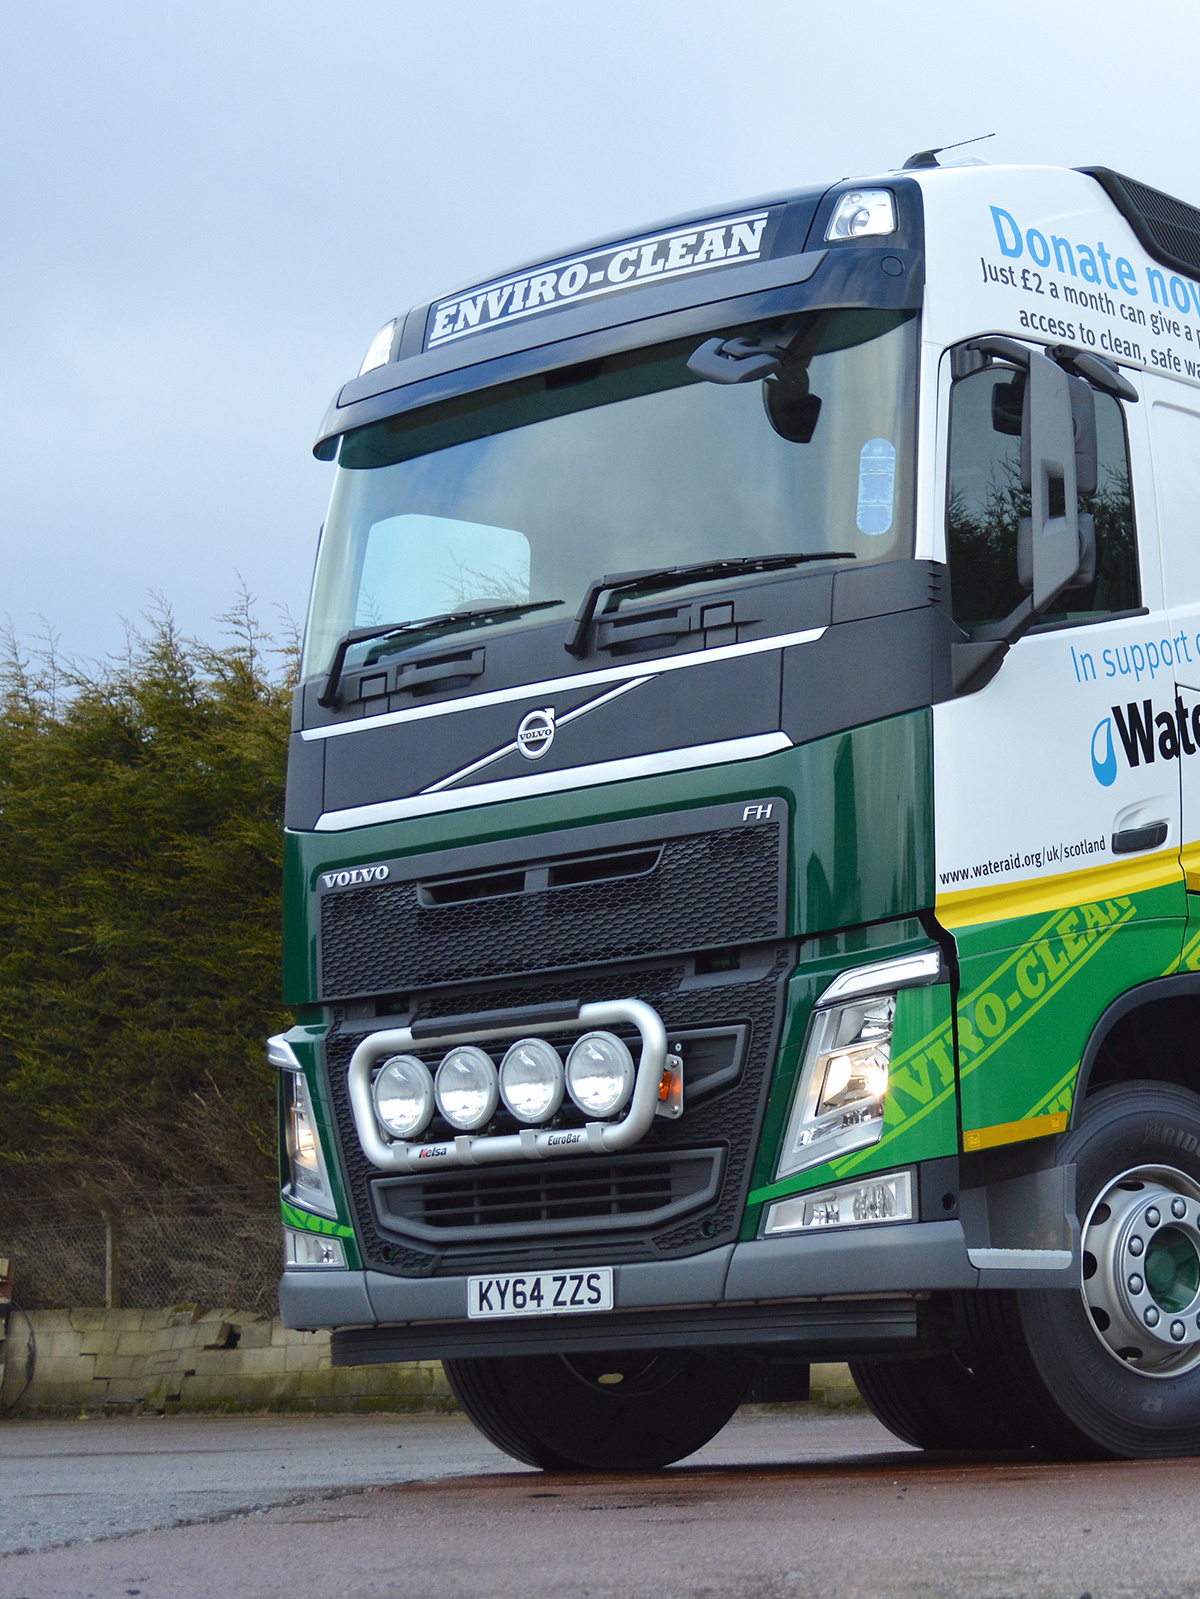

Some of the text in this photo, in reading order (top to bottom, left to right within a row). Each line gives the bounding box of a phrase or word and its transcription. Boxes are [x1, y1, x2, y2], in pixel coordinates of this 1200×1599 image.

[989, 204, 1138, 296] Donate
[430, 219, 768, 340] ENVIRO-CLEAN
[980, 256, 1017, 288] Just
[1020, 268, 1045, 295] £2
[1049, 279, 1060, 299] a
[1063, 284, 1116, 316] month
[1119, 301, 1147, 326] can
[1150, 310, 1181, 338] give
[1184, 323, 1194, 342] a
[1019, 308, 1076, 338] access
[1079, 319, 1096, 346] to
[1100, 328, 1148, 366] clean,
[1149, 346, 1182, 373] safe
[1071, 645, 1096, 683] In
[1104, 629, 1193, 683] support
[519, 728, 553, 742] VOLVO
[742, 802, 774, 823] FH
[322, 864, 390, 889] VOLVO
[939, 835, 1107, 886] www.wateraid.org/uk/scotland
[418, 1146, 448, 1159] Kelsa
[546, 1131, 582, 1147] EuroBar
[478, 1273, 602, 1312] KY64 ZZS
